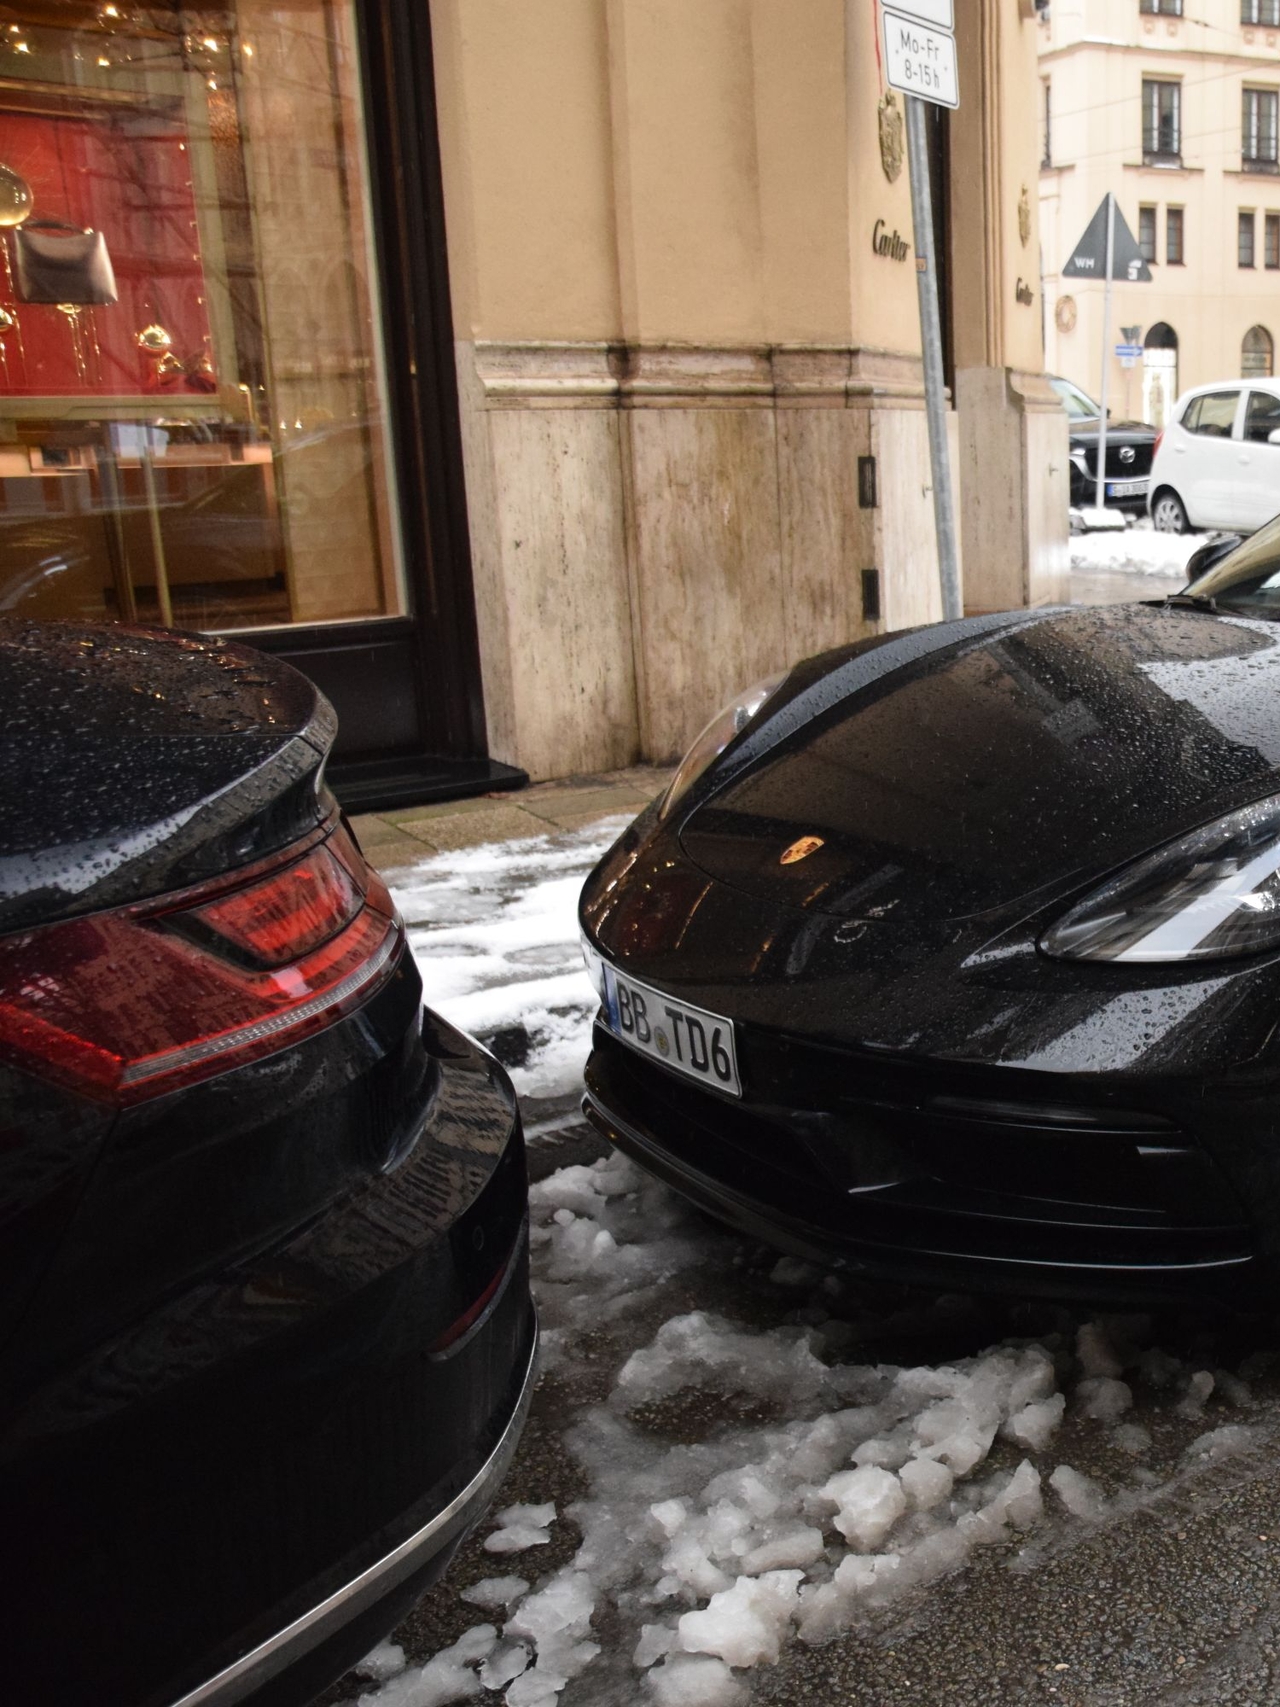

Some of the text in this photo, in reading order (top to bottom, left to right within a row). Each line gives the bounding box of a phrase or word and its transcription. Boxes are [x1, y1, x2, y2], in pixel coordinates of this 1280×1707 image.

[900, 28, 940, 60] Mo-Fr
[616, 980, 732, 1082] BB TD6
